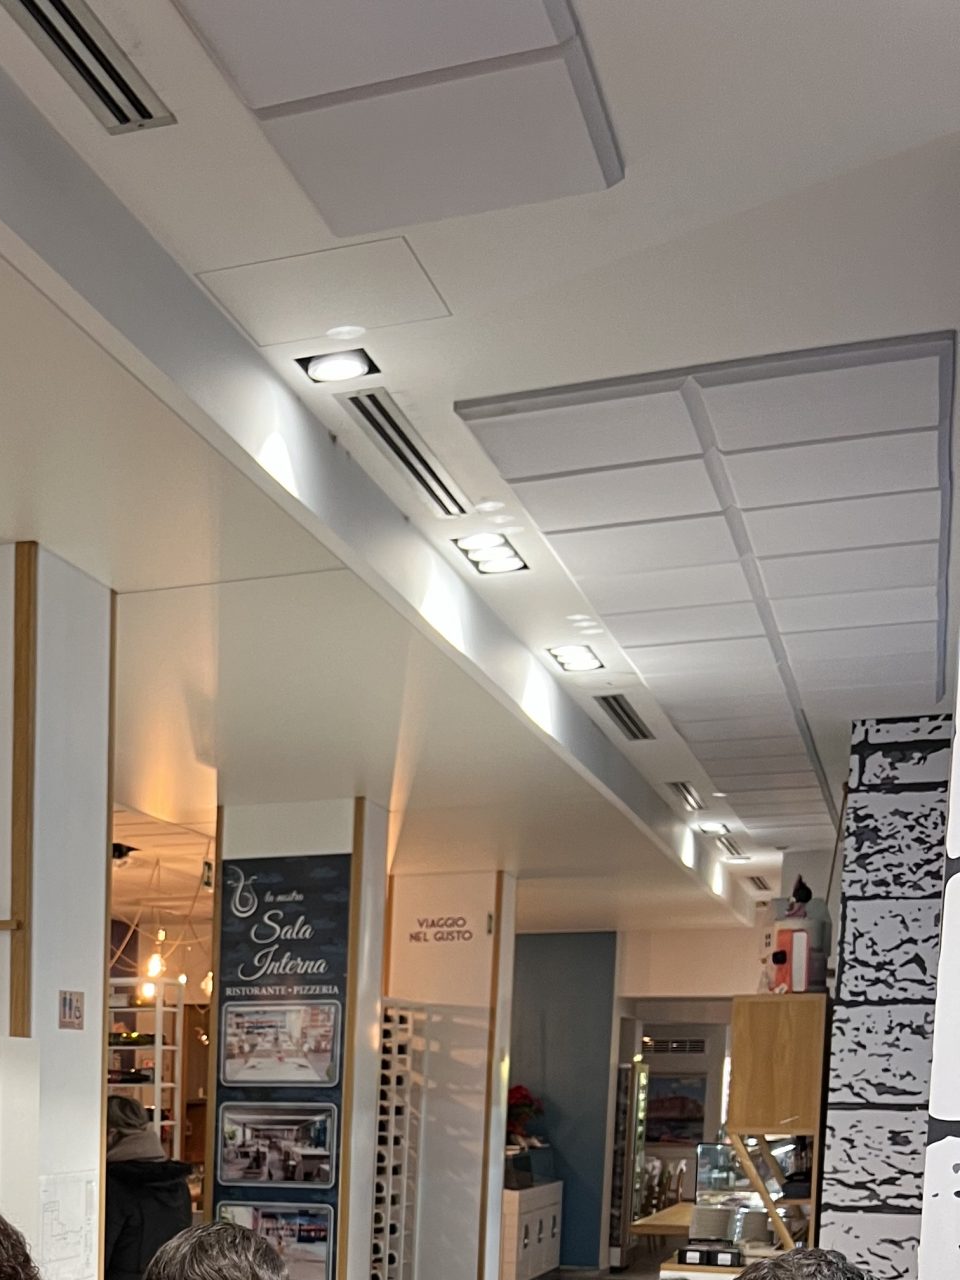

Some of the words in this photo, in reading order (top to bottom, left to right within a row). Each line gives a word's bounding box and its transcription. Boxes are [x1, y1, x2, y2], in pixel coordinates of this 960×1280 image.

[250, 909, 315, 944] Sala
[417, 917, 467, 928] VIAGGIO
[409, 931, 429, 943] NEL
[433, 930, 473, 941] GUSTO
[237, 943, 329, 981] Interna
[225, 985, 286, 996] RISTORANTE
[293, 985, 339, 996] PIZZERIA
